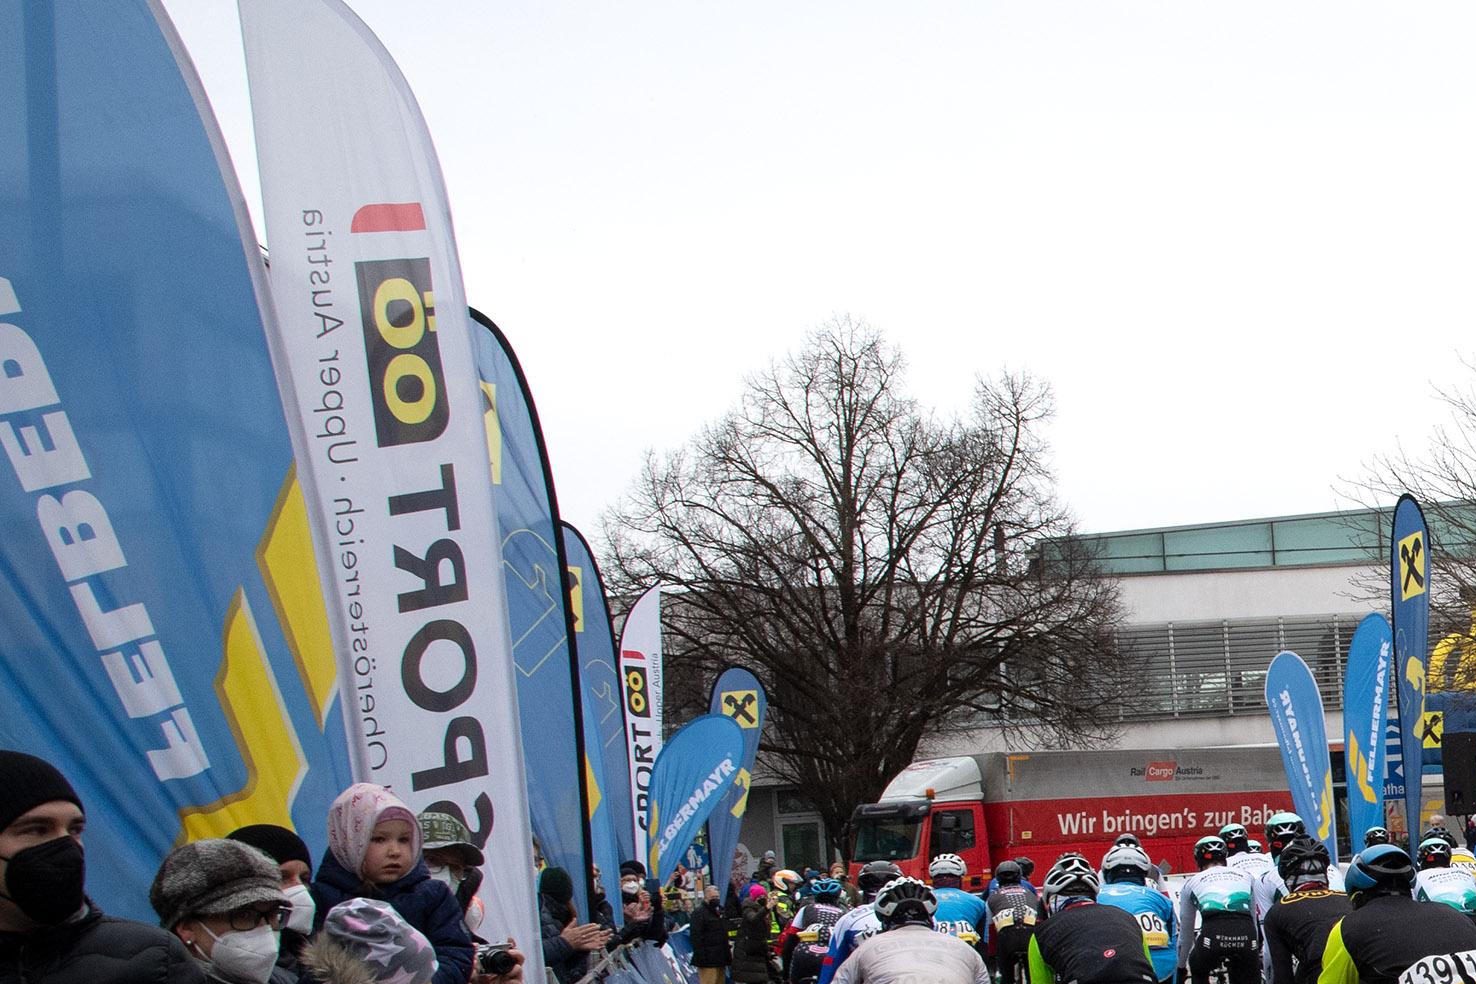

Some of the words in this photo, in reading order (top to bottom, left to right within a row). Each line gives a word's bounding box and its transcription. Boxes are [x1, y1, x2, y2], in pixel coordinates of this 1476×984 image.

[1367, 640, 1391, 784] FELBERMAYR
[1130, 766, 1145, 777] Rail
[1149, 766, 1174, 778] Cargo
[1175, 765, 1203, 776] Austria
[1382, 784, 1405, 796] atha
[1058, 812, 1096, 836] Wir
[1101, 807, 1197, 836] bringen's
[1203, 808, 1236, 828] zur
[1140, 913, 1163, 932] 06
